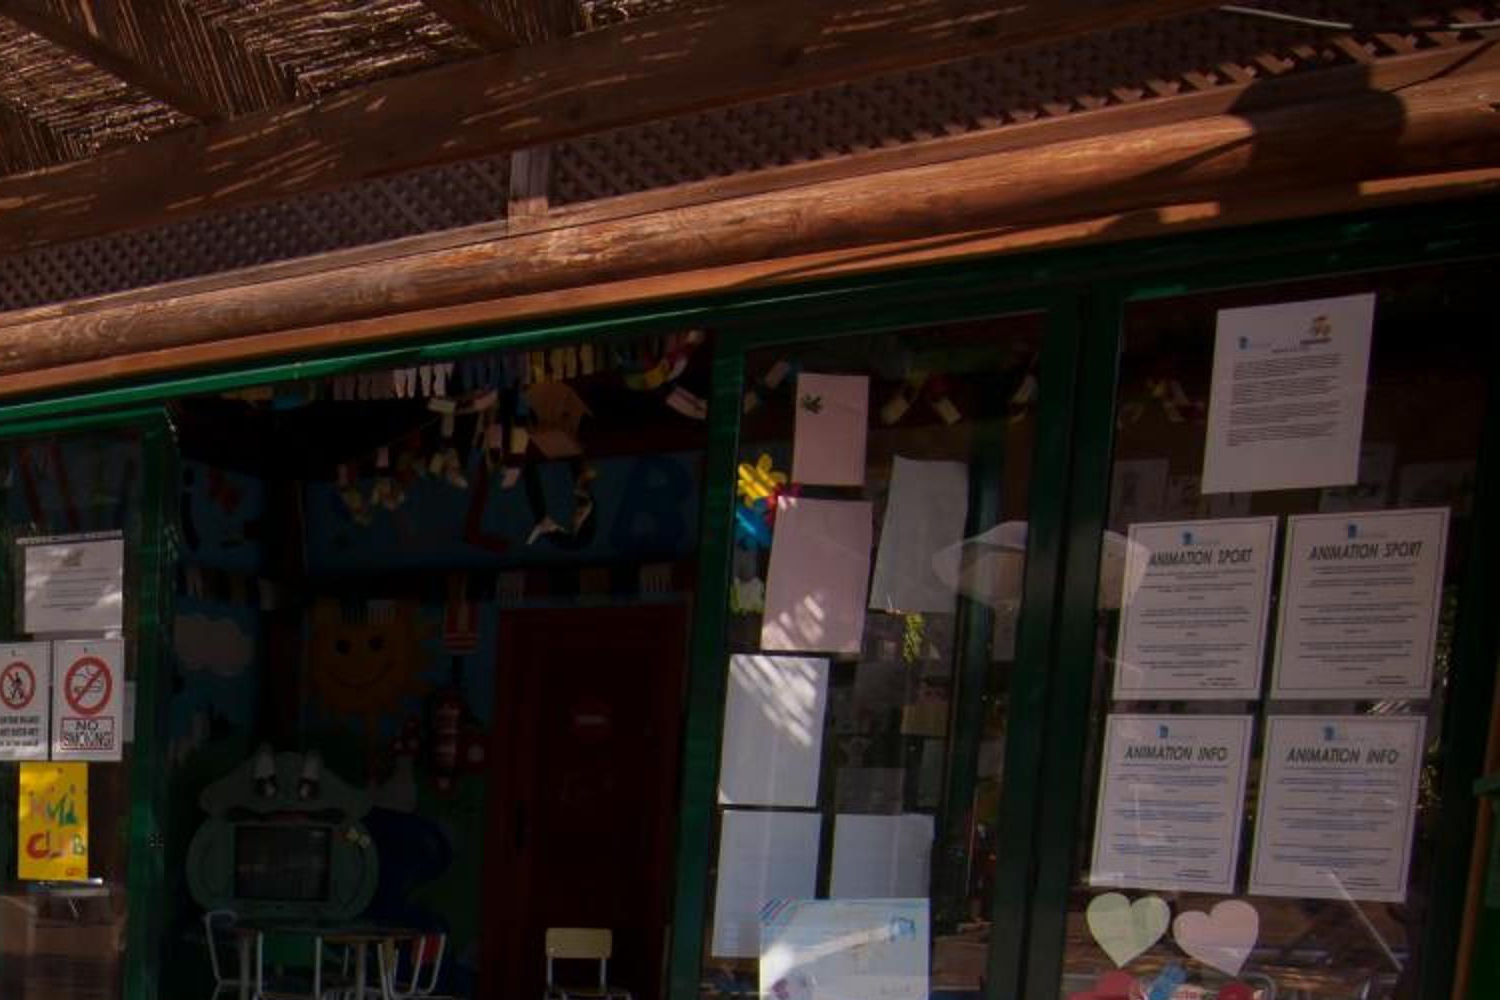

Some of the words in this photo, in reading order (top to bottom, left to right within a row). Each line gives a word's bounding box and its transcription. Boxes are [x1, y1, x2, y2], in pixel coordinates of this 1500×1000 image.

[1148, 548, 1213, 566] ANIMATION
[1217, 547, 1253, 564] SPORT
[1308, 543, 1379, 561] ANIMATION
[1383, 540, 1424, 559] SPORT
[74, 720, 99, 732] NO
[1123, 746, 1193, 761] ANIMATION
[1197, 747, 1229, 762] INFO
[1285, 747, 1361, 764] ANIMATION
[1366, 748, 1399, 765] INFO
